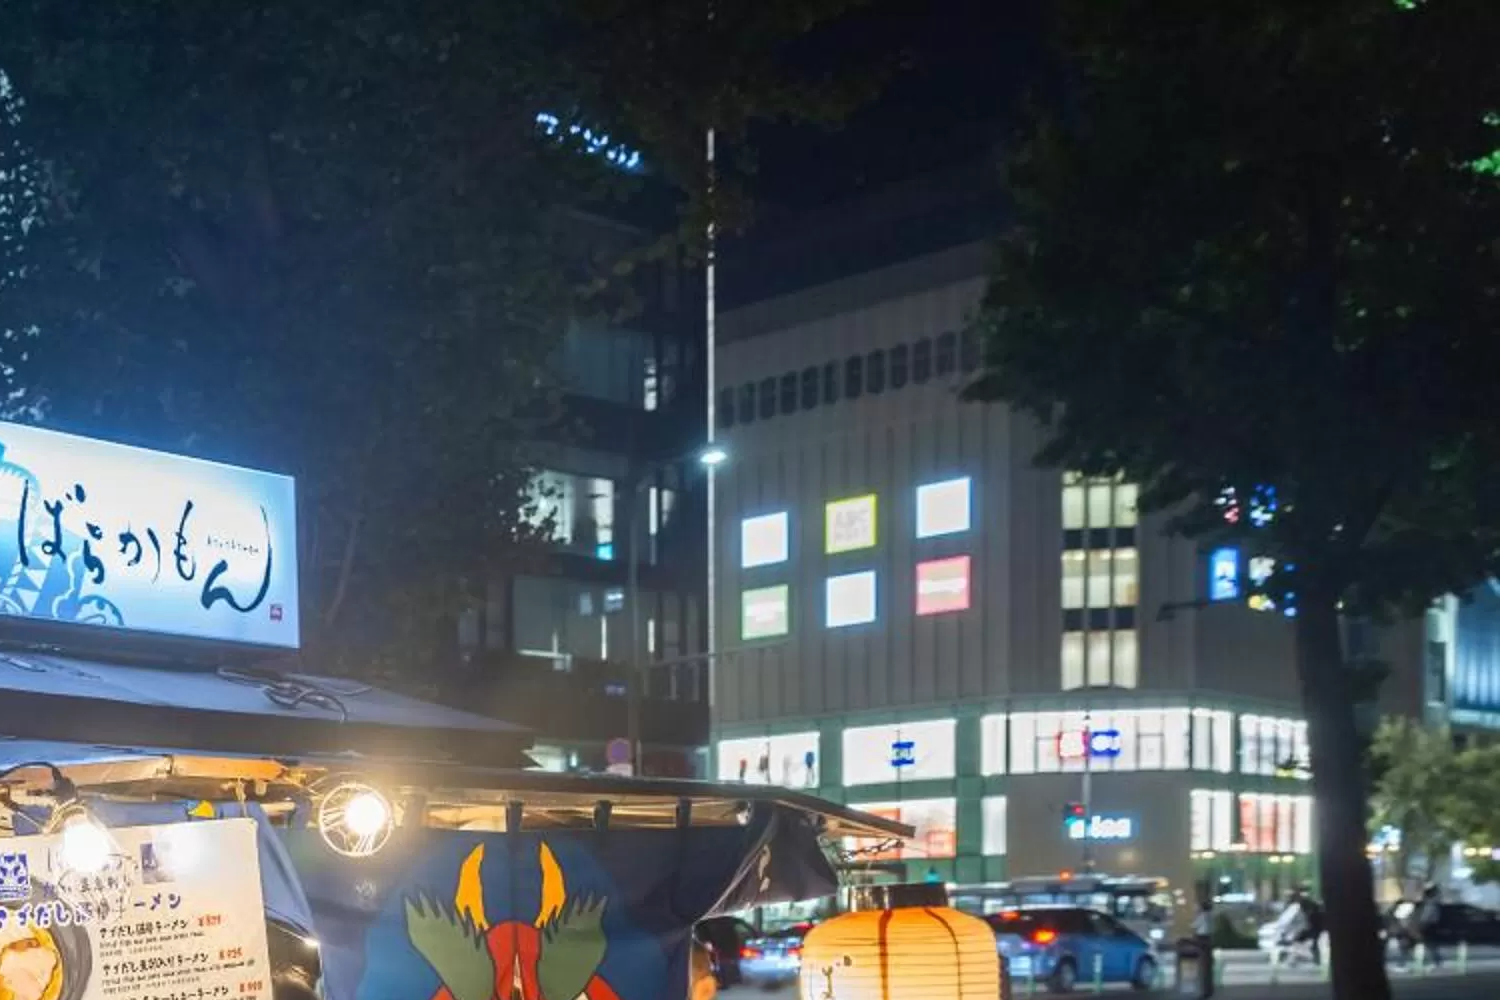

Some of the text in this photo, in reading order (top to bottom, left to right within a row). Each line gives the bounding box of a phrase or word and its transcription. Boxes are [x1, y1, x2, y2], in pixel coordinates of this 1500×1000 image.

[17, 481, 272, 612] ばらかもん
